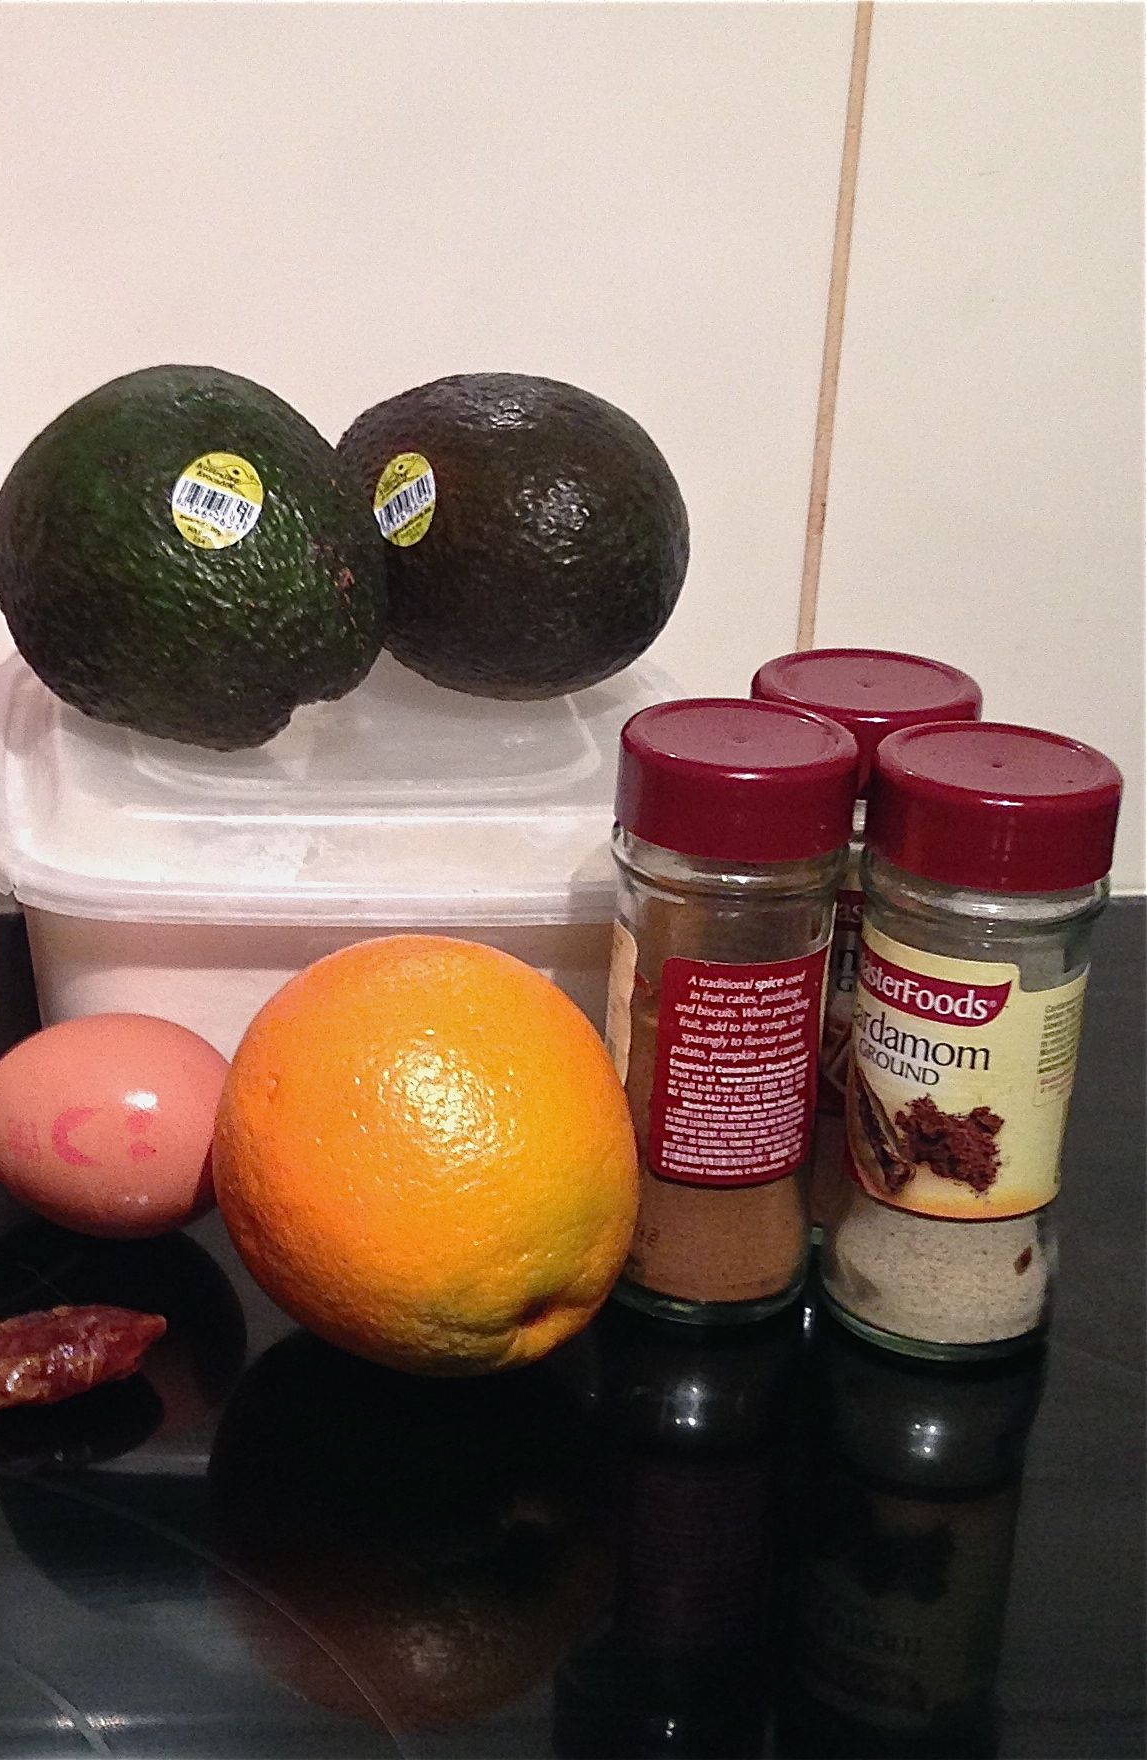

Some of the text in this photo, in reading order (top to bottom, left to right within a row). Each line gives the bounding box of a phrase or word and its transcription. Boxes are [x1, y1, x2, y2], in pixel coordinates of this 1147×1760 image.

[688, 976, 697, 985] A
[755, 976, 784, 992] spice
[861, 960, 989, 1020] asterFoods
[702, 991, 724, 1003] fruit
[726, 993, 758, 1004] cakes,
[675, 1003, 696, 1014] and
[697, 1004, 738, 1018] biscuits.
[742, 1006, 772, 1017] When
[705, 1021, 728, 1032] add
[729, 1023, 740, 1032] to
[742, 1021, 759, 1032] the
[682, 1033, 729, 1049] sparingly
[730, 1037, 743, 1046] to
[743, 1035, 778, 1046] flavour
[853, 1005, 990, 1070] ardamom
[670, 1045, 707, 1060] potato,
[709, 1050, 757, 1063] pumpkin
[758, 1046, 778, 1059] and
